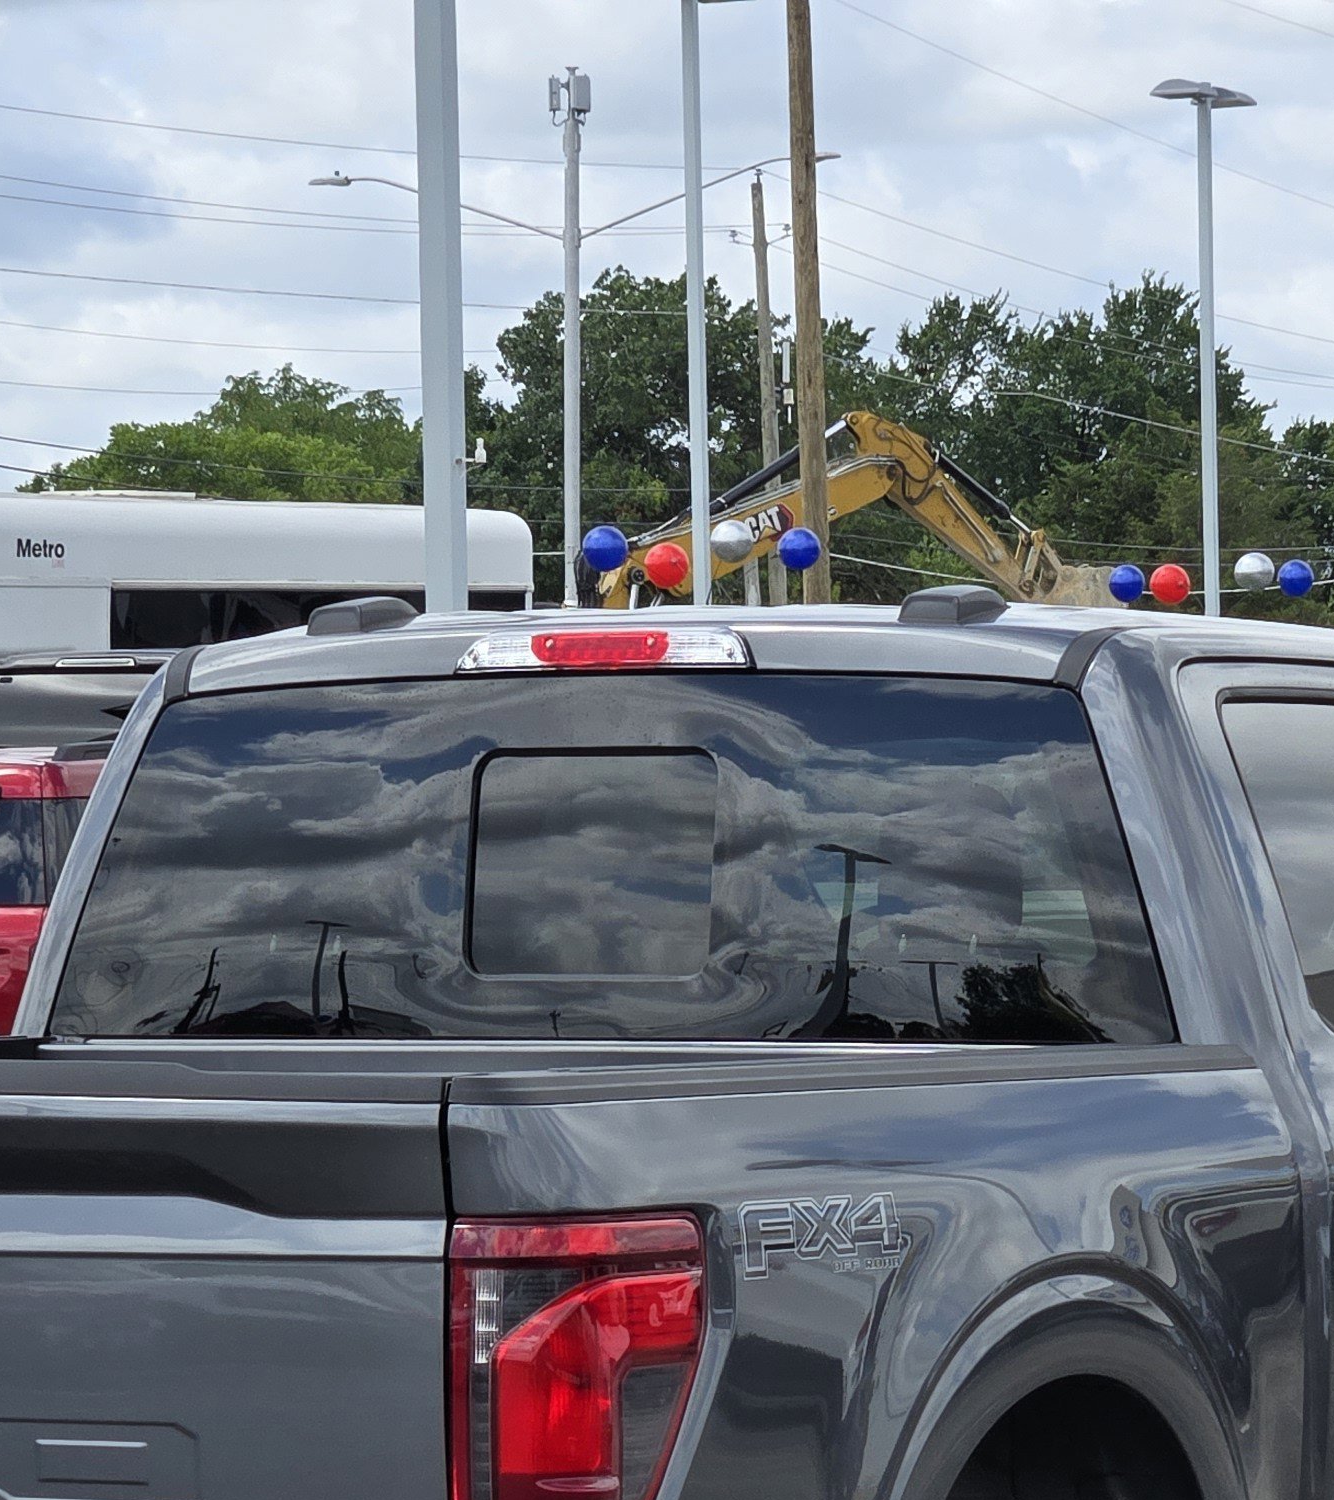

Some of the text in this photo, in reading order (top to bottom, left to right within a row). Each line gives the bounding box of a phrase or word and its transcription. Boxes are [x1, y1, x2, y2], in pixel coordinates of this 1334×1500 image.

[745, 505, 782, 543] CAT
[16, 538, 65, 558] Metro
[737, 1192, 902, 1281] FX4
